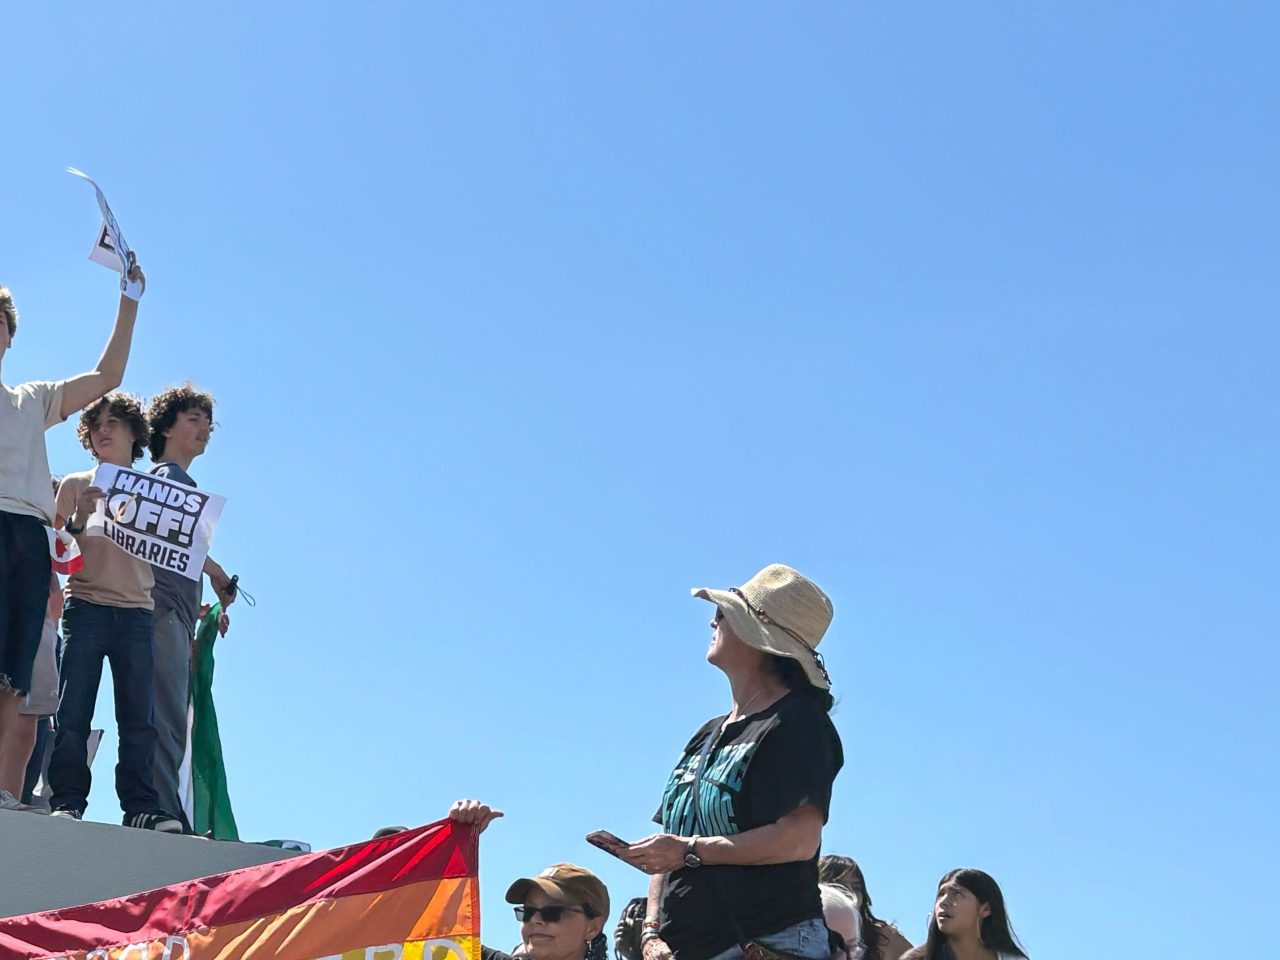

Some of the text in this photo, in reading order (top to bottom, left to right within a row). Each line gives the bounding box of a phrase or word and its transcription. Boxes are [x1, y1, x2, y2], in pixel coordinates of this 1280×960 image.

[108, 493, 196, 545] OFF!
[115, 472, 203, 514] HANDS
[103, 519, 191, 574] LIBRARIES
